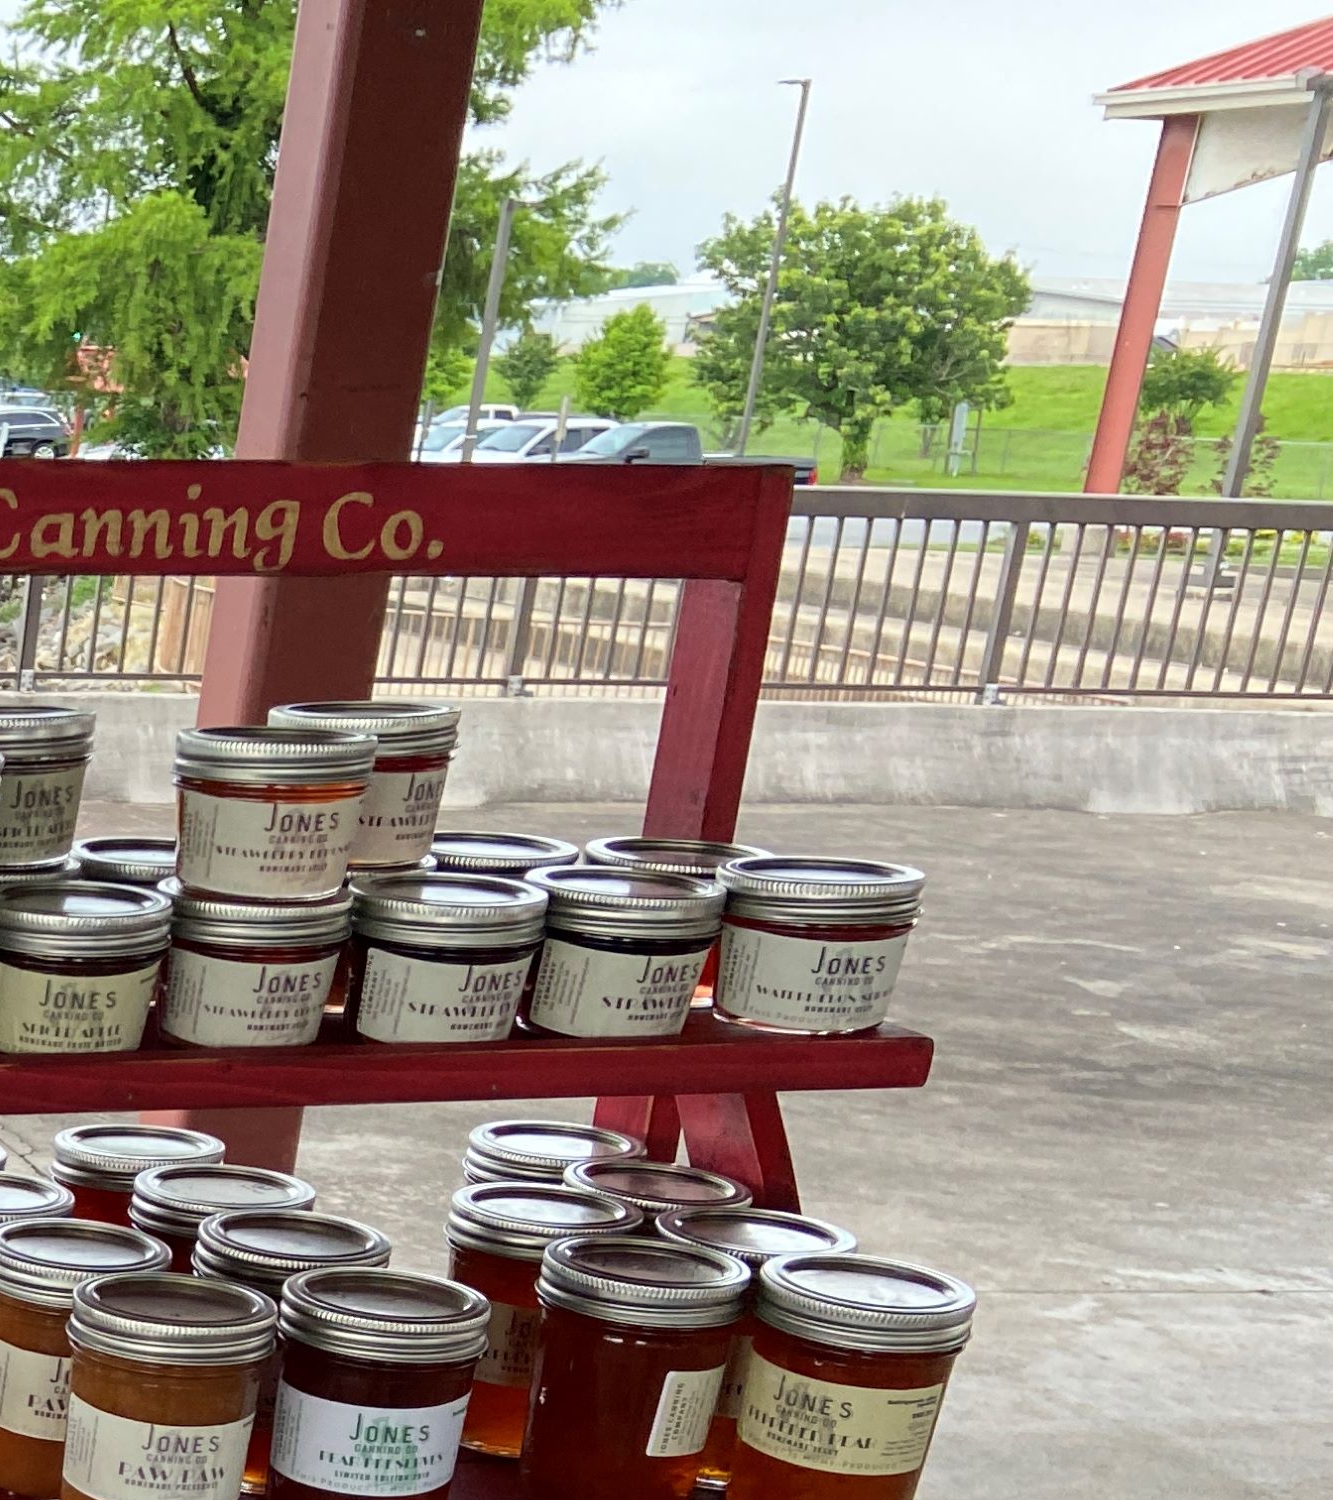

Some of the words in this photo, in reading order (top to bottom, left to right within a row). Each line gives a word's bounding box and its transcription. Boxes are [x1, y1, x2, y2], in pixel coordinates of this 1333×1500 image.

[322, 491, 445, 560] Co.
[10, 781, 74, 809] JONES
[264, 803, 340, 833] JONES
[636, 957, 700, 984] JONES
[811, 947, 886, 975] JONES
[252, 966, 323, 993] JONES
[458, 965, 523, 993] JONES
[39, 979, 117, 1010] JONES
[773, 1375, 853, 1419] JONES
[141, 1424, 220, 1454] JONES
[349, 1413, 430, 1444] JONES
[118, 1461, 174, 1481] PAW
[181, 1466, 225, 1483] PAW
